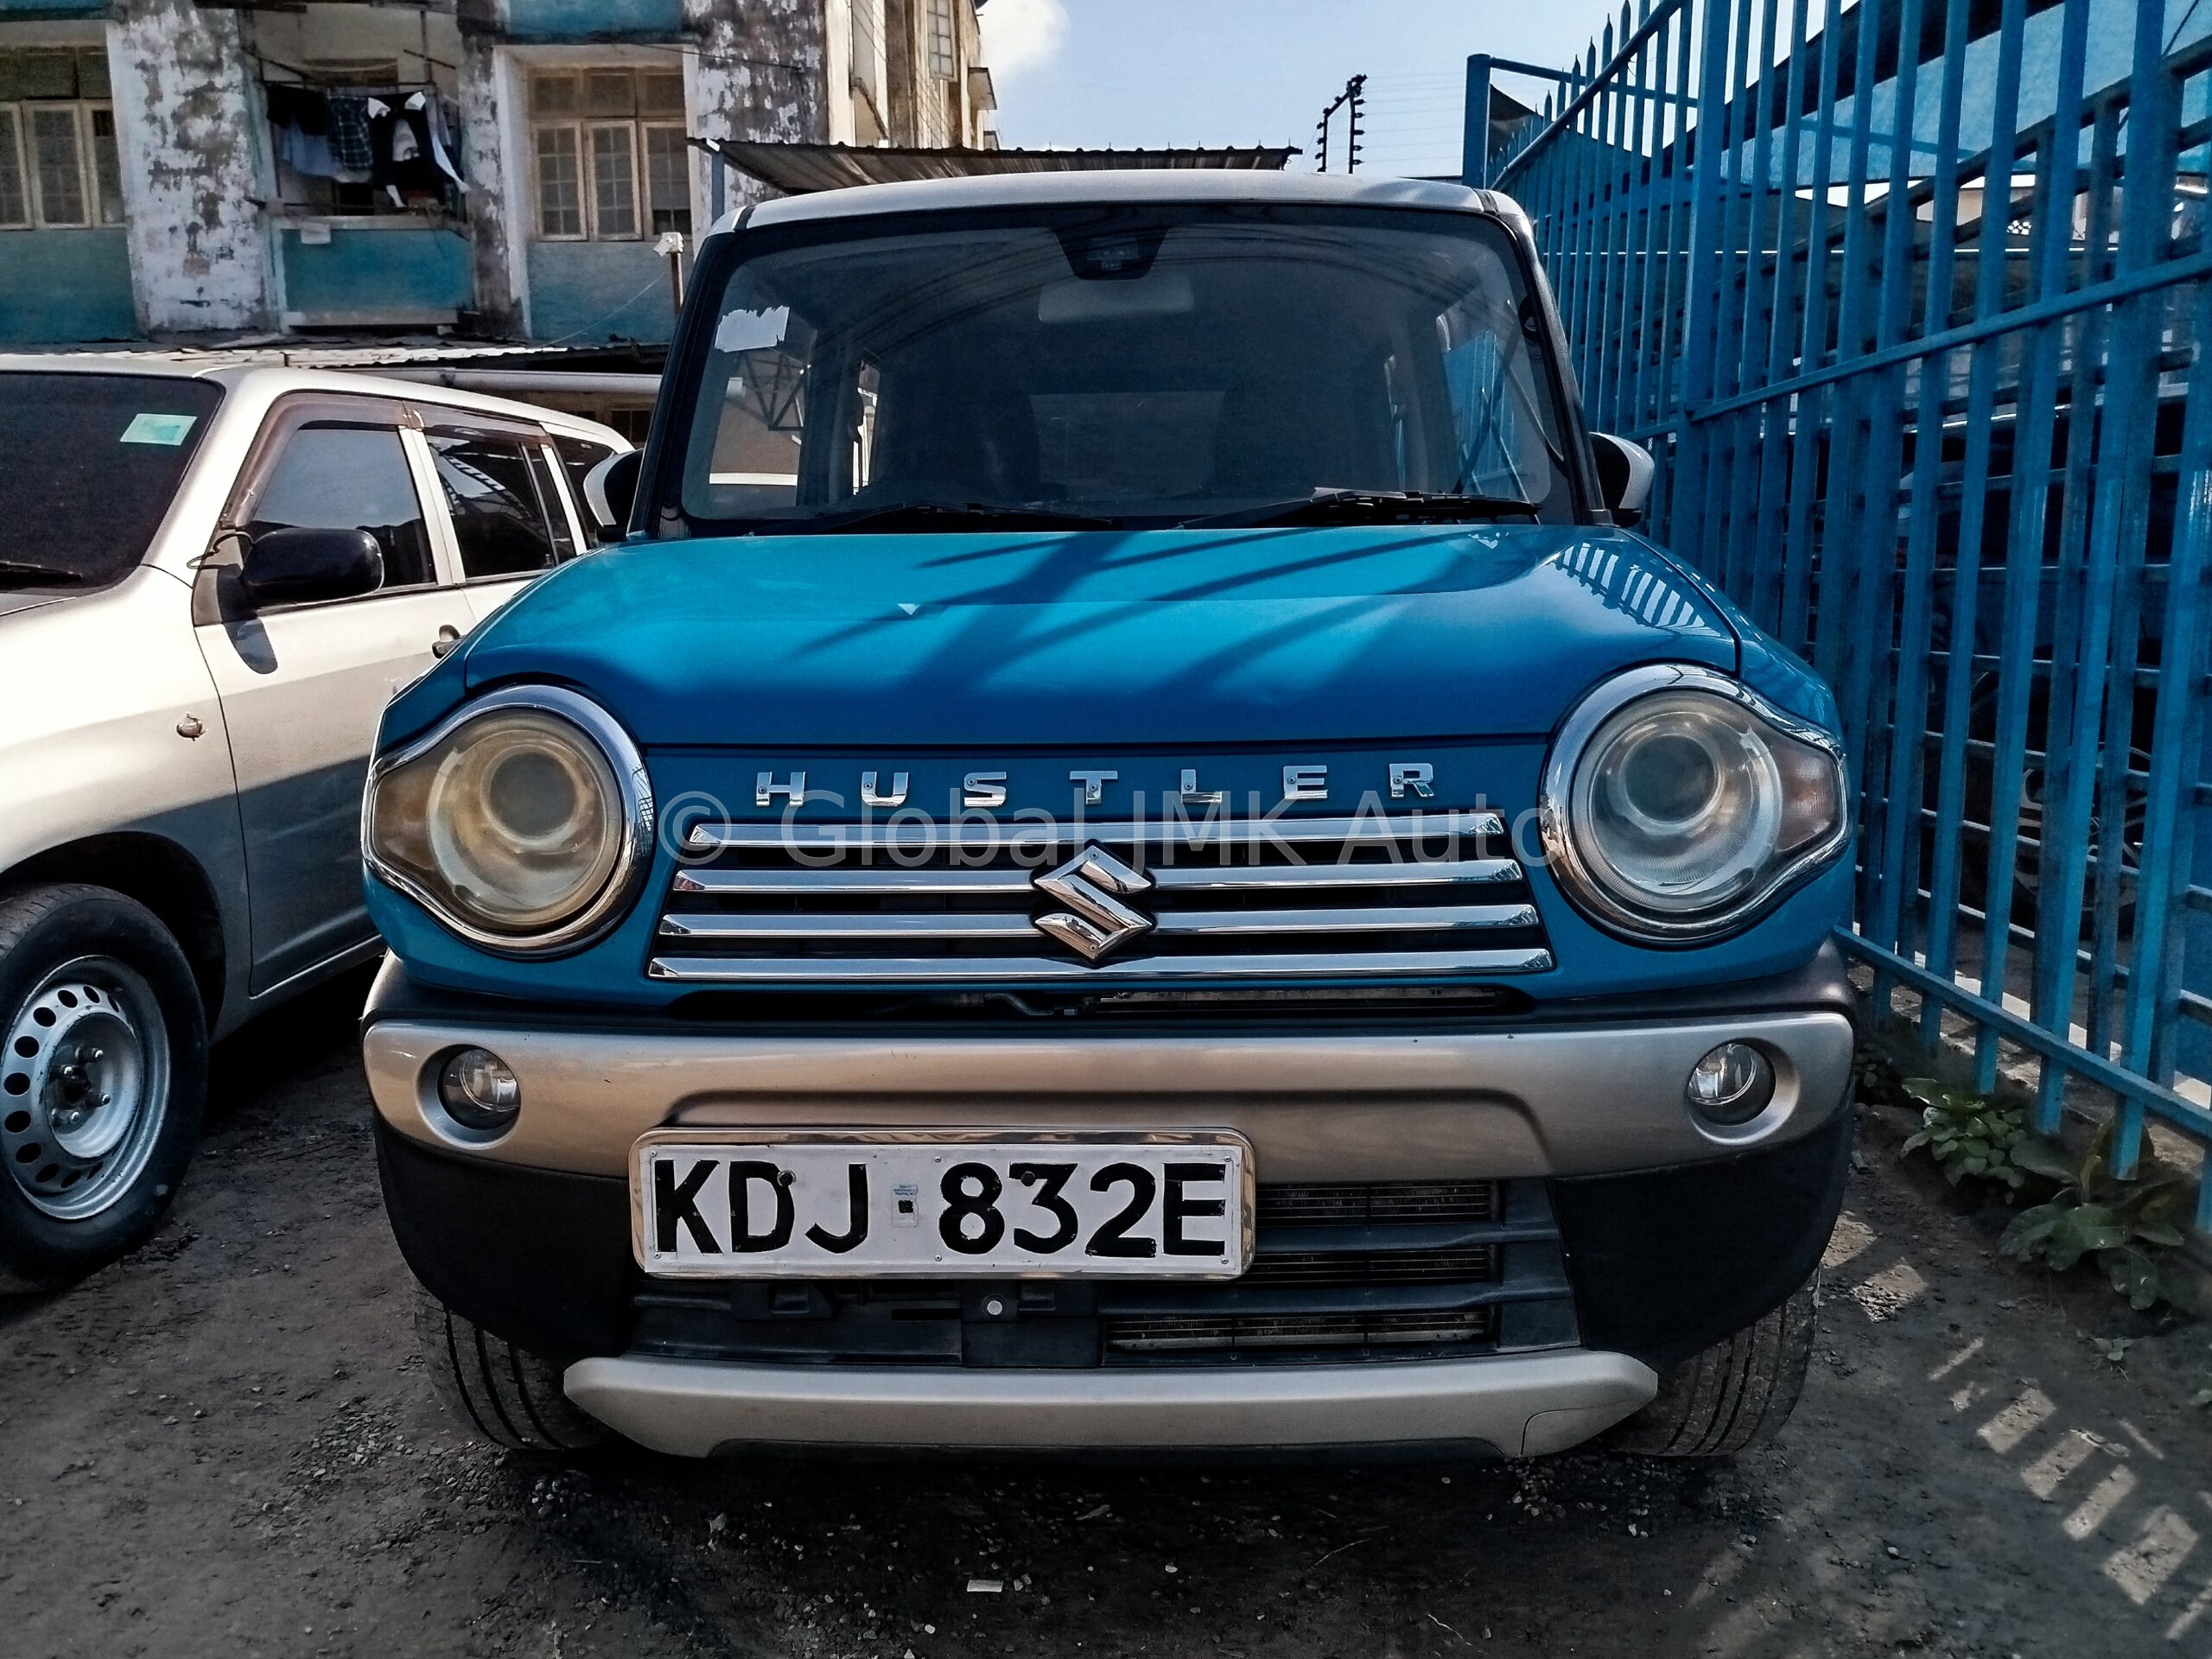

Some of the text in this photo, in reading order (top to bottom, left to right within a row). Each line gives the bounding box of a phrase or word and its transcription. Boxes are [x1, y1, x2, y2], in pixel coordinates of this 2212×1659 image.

[755, 762, 1435, 807] HUSTLER
[654, 1160, 1226, 1258] KDJ 832E
